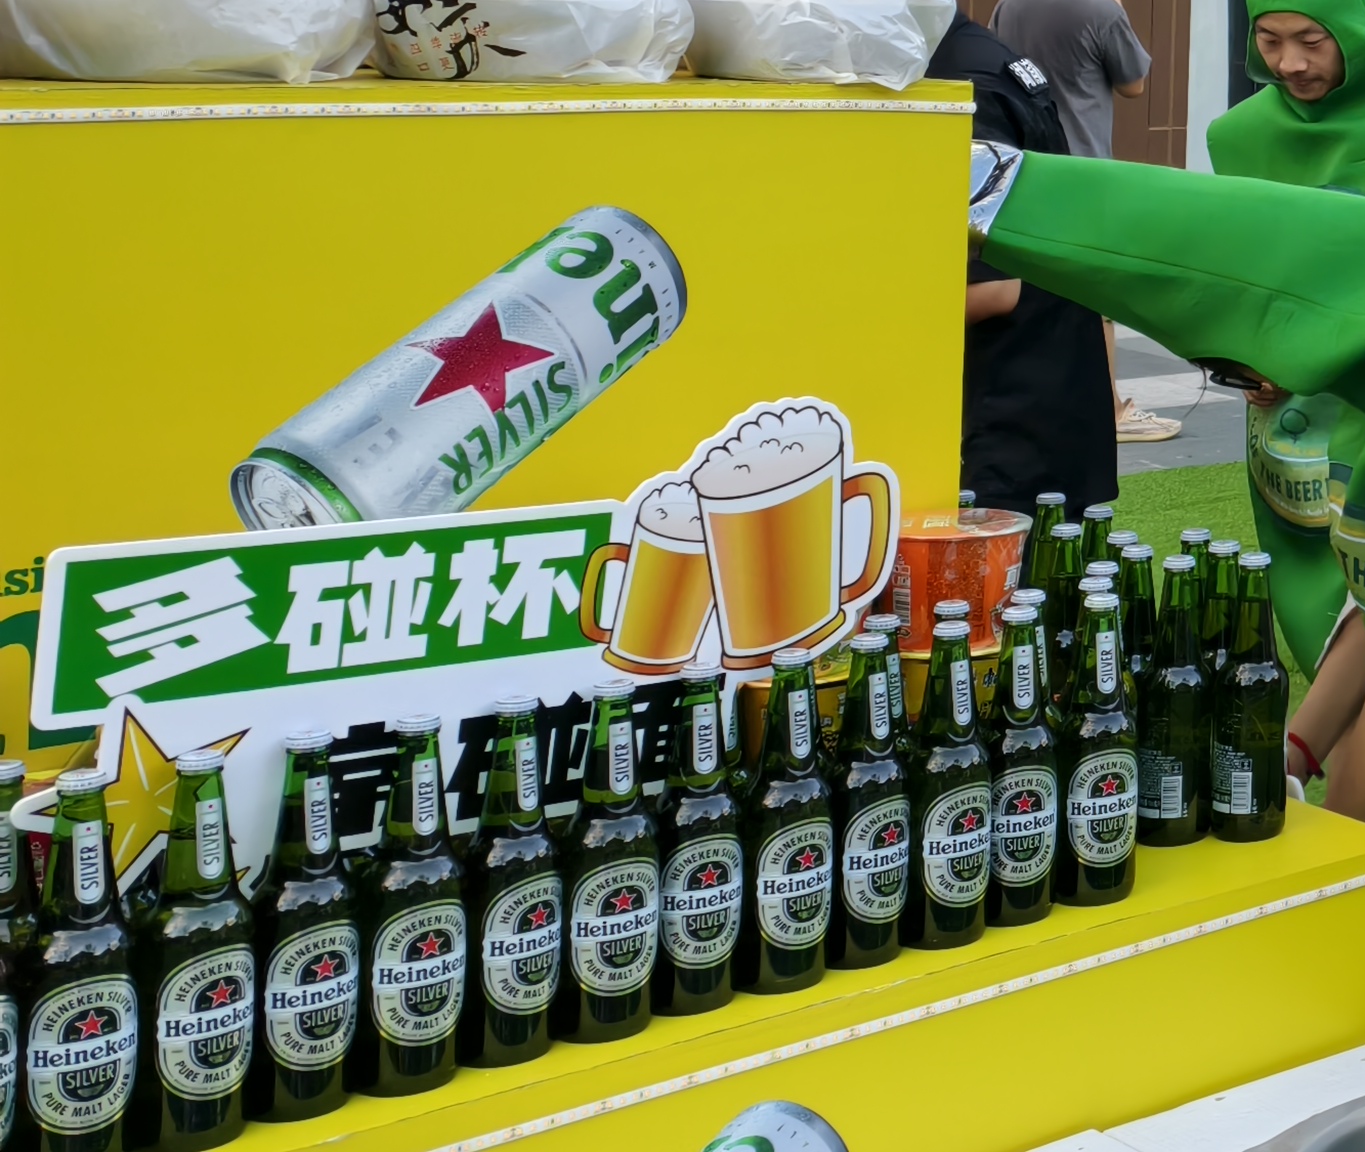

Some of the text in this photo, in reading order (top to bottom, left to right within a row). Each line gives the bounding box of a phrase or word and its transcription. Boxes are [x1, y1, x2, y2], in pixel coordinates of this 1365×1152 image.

[438, 361, 575, 496] SILVER
[1285, 478, 1323, 503] BEER
[92, 528, 588, 697] 多碰杯
[1018, 663, 1030, 698] SILVER
[1101, 649, 1114, 684] SILVER
[889, 671, 901, 708] SILVER
[958, 679, 969, 714] SILVER
[875, 691, 887, 728] SILVER
[795, 709, 809, 746] SILVER
[698, 723, 713, 762] SILVER
[614, 742, 629, 781] SILVER
[1077, 761, 1118, 789] HEINEKEN
[522, 757, 536, 799] SILVER
[993, 778, 1033, 806] HEINEKEN
[419, 780, 434, 823] SILVER
[936, 796, 979, 827] HEINEKEN
[1070, 795, 1137, 817] Heineken
[312, 798, 327, 842] SILVER
[857, 809, 899, 841] HEINEKEN
[1091, 814, 1125, 833] SILVER
[203, 821, 220, 866] SILVER
[770, 831, 816, 865] HEINEKEN
[1006, 834, 1040, 851] SILVER
[1077, 835, 1095, 854] PURE
[1096, 842, 1118, 855] MALT
[80, 843, 99, 892] SILVER
[670, 848, 719, 881] HEINEKEN
[953, 853, 983, 871] SILVER
[991, 852, 1008, 873] PURE
[1010, 860, 1032, 874] MALT
[584, 873, 635, 906] HEINEKEN
[662, 885, 741, 912] Heineken
[936, 874, 978, 894] PURE MALT
[499, 887, 549, 925] HEINEKEN
[789, 892, 822, 913] SILVER
[856, 890, 898, 910] PURE MALT
[386, 915, 442, 952] HEINEKEN
[576, 909, 657, 938] Heineken
[688, 909, 726, 931] SILVER
[771, 914, 791, 935] PURE
[792, 923, 815, 936] MALT
[280, 937, 336, 976] HEINEKEN
[602, 935, 643, 957] SILVER
[669, 932, 690, 953] PURE
[692, 940, 717, 955] MALT
[175, 961, 232, 1003] HEINEKEN
[378, 955, 465, 986] Heineken
[584, 959, 606, 981] PURE
[607, 968, 634, 982] MALT
[408, 981, 449, 1004] SILVER
[498, 977, 547, 1000] PURE MALT
[42, 992, 104, 1032] HEINEKEN
[302, 1003, 344, 1029] SILVER
[386, 1007, 409, 1031] PURE
[411, 1017, 439, 1032] MALT
[32, 1032, 136, 1068] Heineken
[197, 1030, 240, 1057] SILVER
[281, 1031, 305, 1054] PURE
[307, 1040, 335, 1055] MALT
[66, 1065, 115, 1090] SILVER
[175, 1059, 201, 1084] PURE
[202, 1068, 231, 1084] MALT
[42, 1092, 69, 1116] PURE
[71, 1104, 103, 1118] MALT
